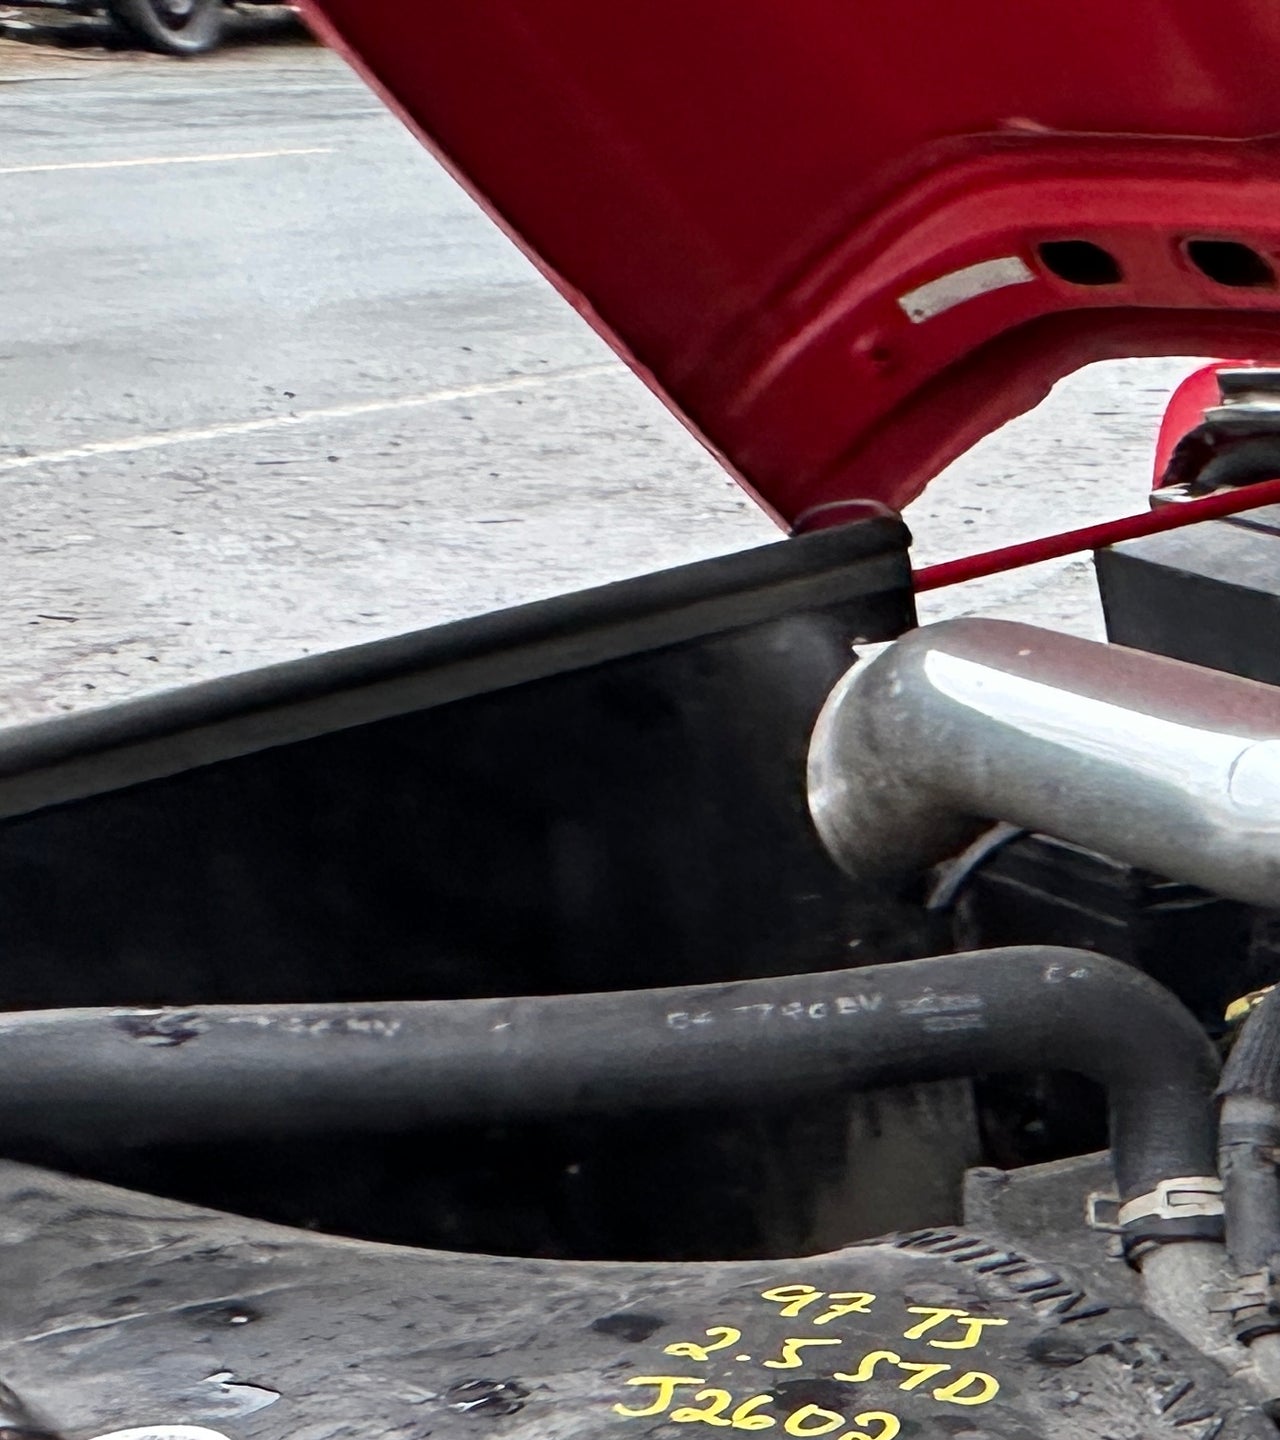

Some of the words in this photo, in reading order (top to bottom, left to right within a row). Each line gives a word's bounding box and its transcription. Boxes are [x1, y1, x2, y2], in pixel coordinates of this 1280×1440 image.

[761, 1284, 876, 1326] 97
[903, 1306, 1008, 1350] TJ
[664, 1327, 842, 1369] 2.5
[833, 1350, 1000, 1406] STD
